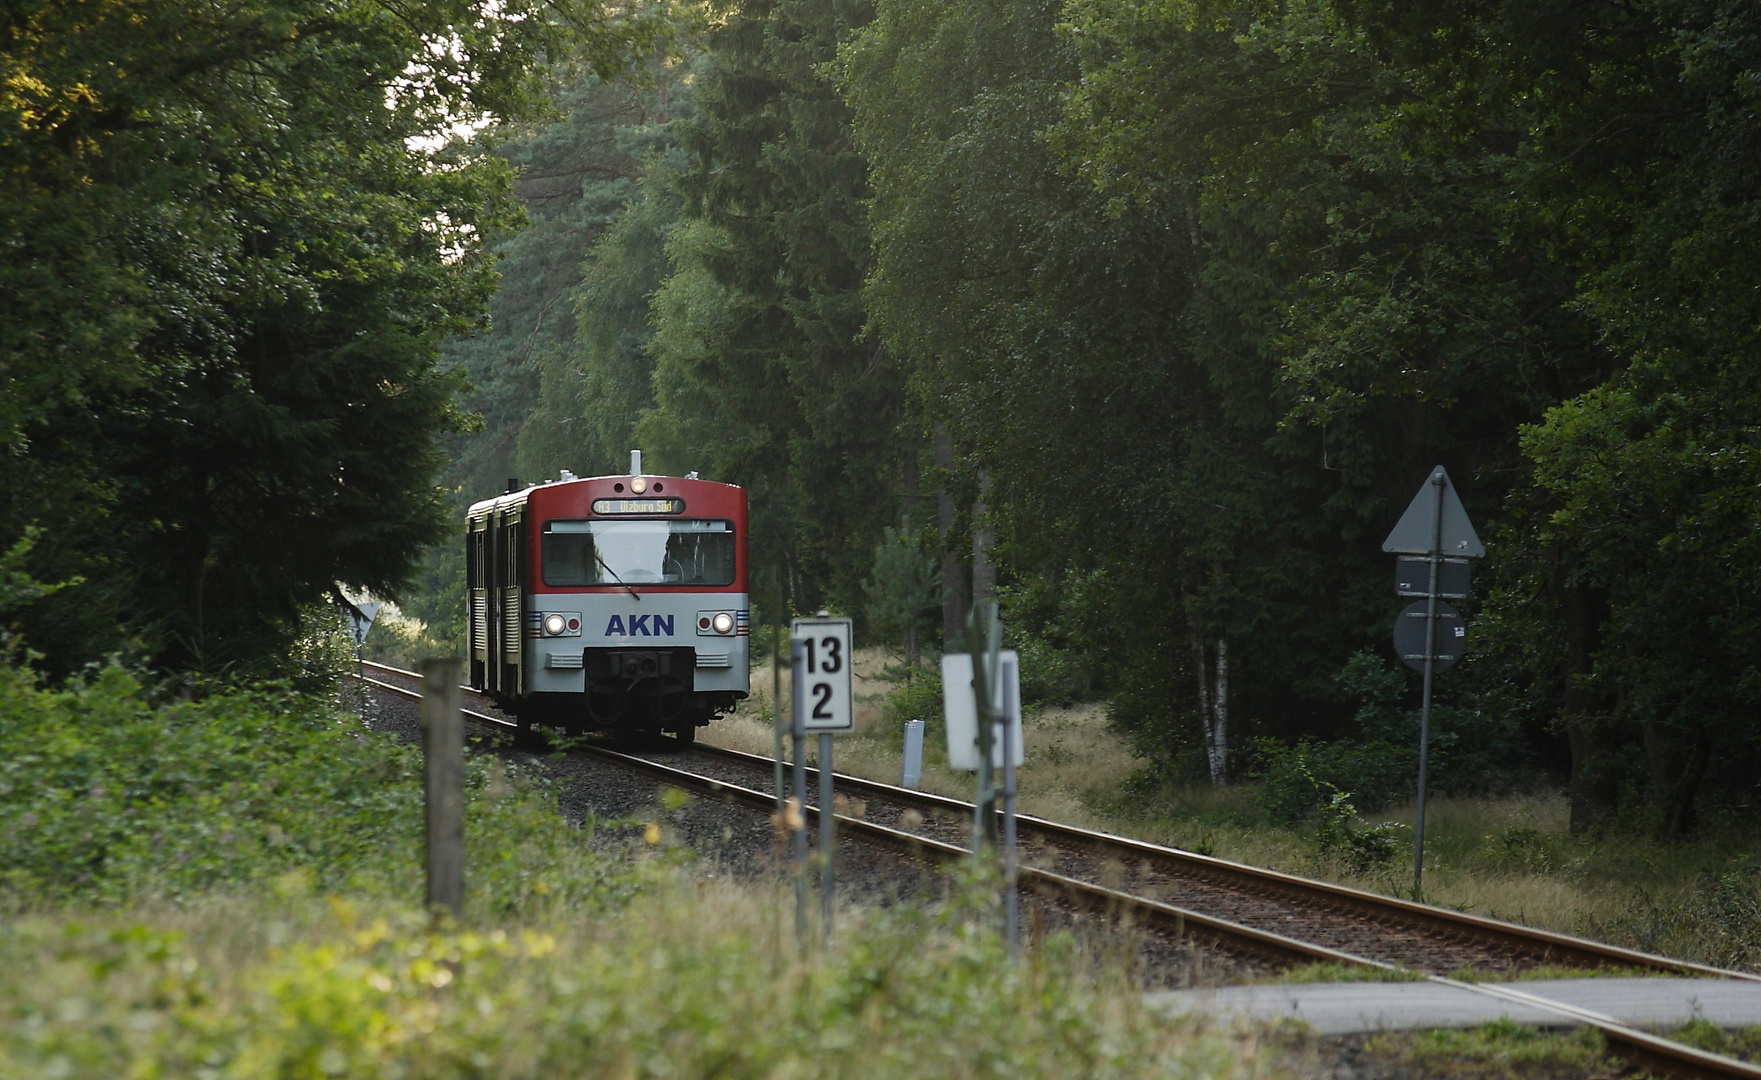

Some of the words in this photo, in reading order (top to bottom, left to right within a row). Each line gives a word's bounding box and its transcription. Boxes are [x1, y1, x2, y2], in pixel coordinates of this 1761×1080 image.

[598, 501, 610, 513] A3
[620, 500, 654, 513] Ulzburg
[604, 614, 675, 637] AKN
[804, 637, 842, 673] 13
[812, 682, 833, 719] 2
